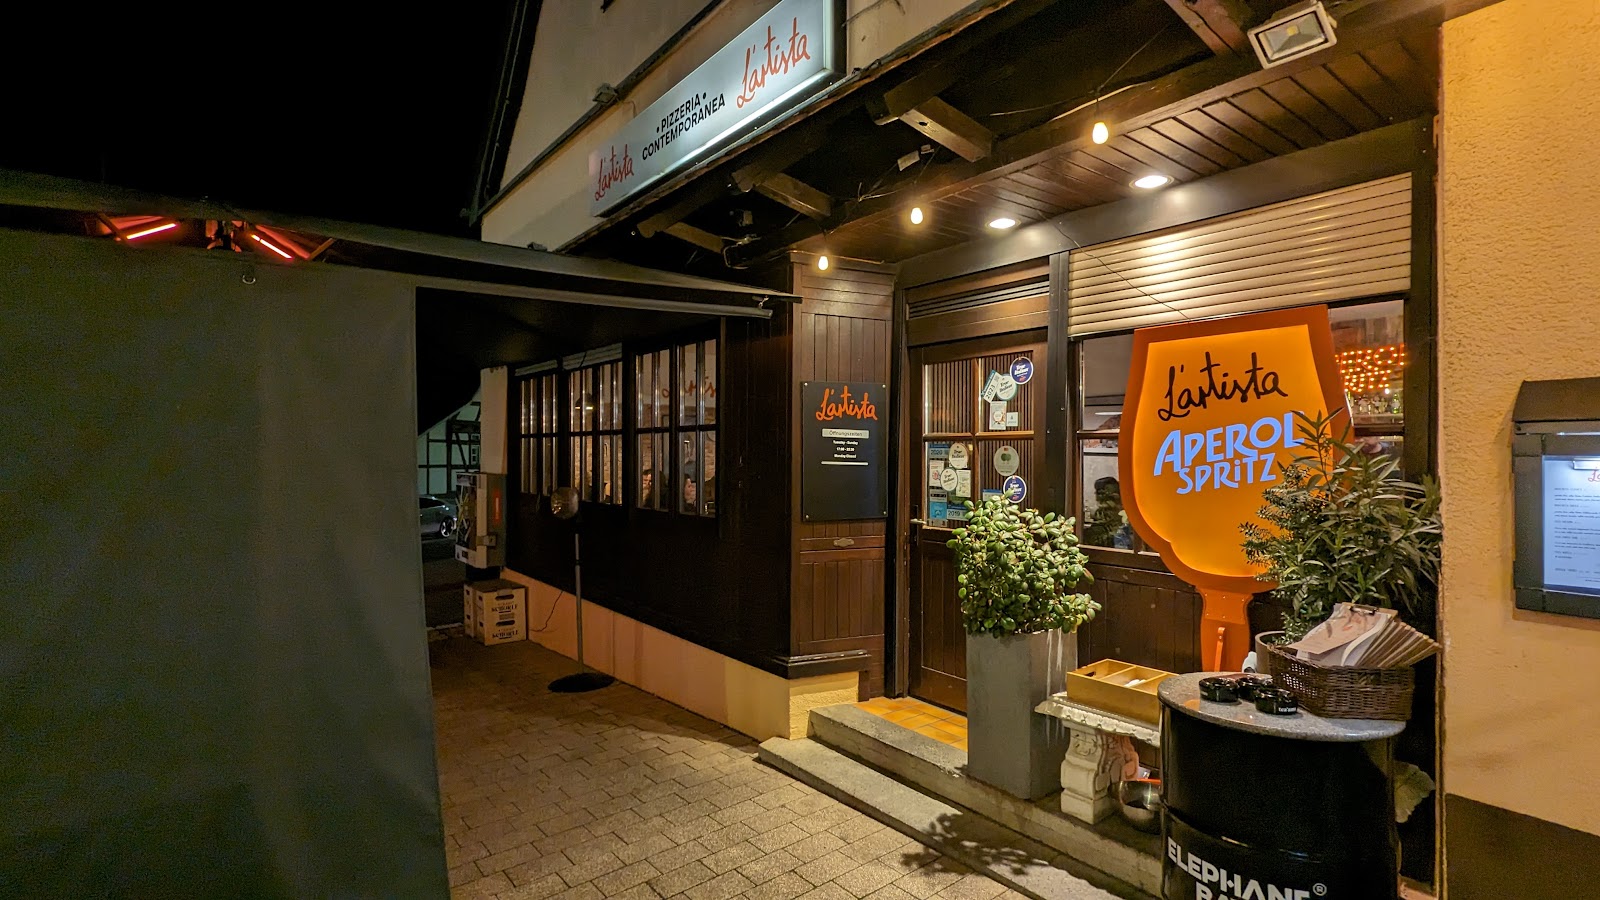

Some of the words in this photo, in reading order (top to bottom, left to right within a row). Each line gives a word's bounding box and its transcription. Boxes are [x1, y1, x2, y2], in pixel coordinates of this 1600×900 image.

[641, 93, 726, 161] CONTEMPORANEA
[660, 93, 701, 134] PIZZERIA
[1153, 411, 1305, 477] APEROL
